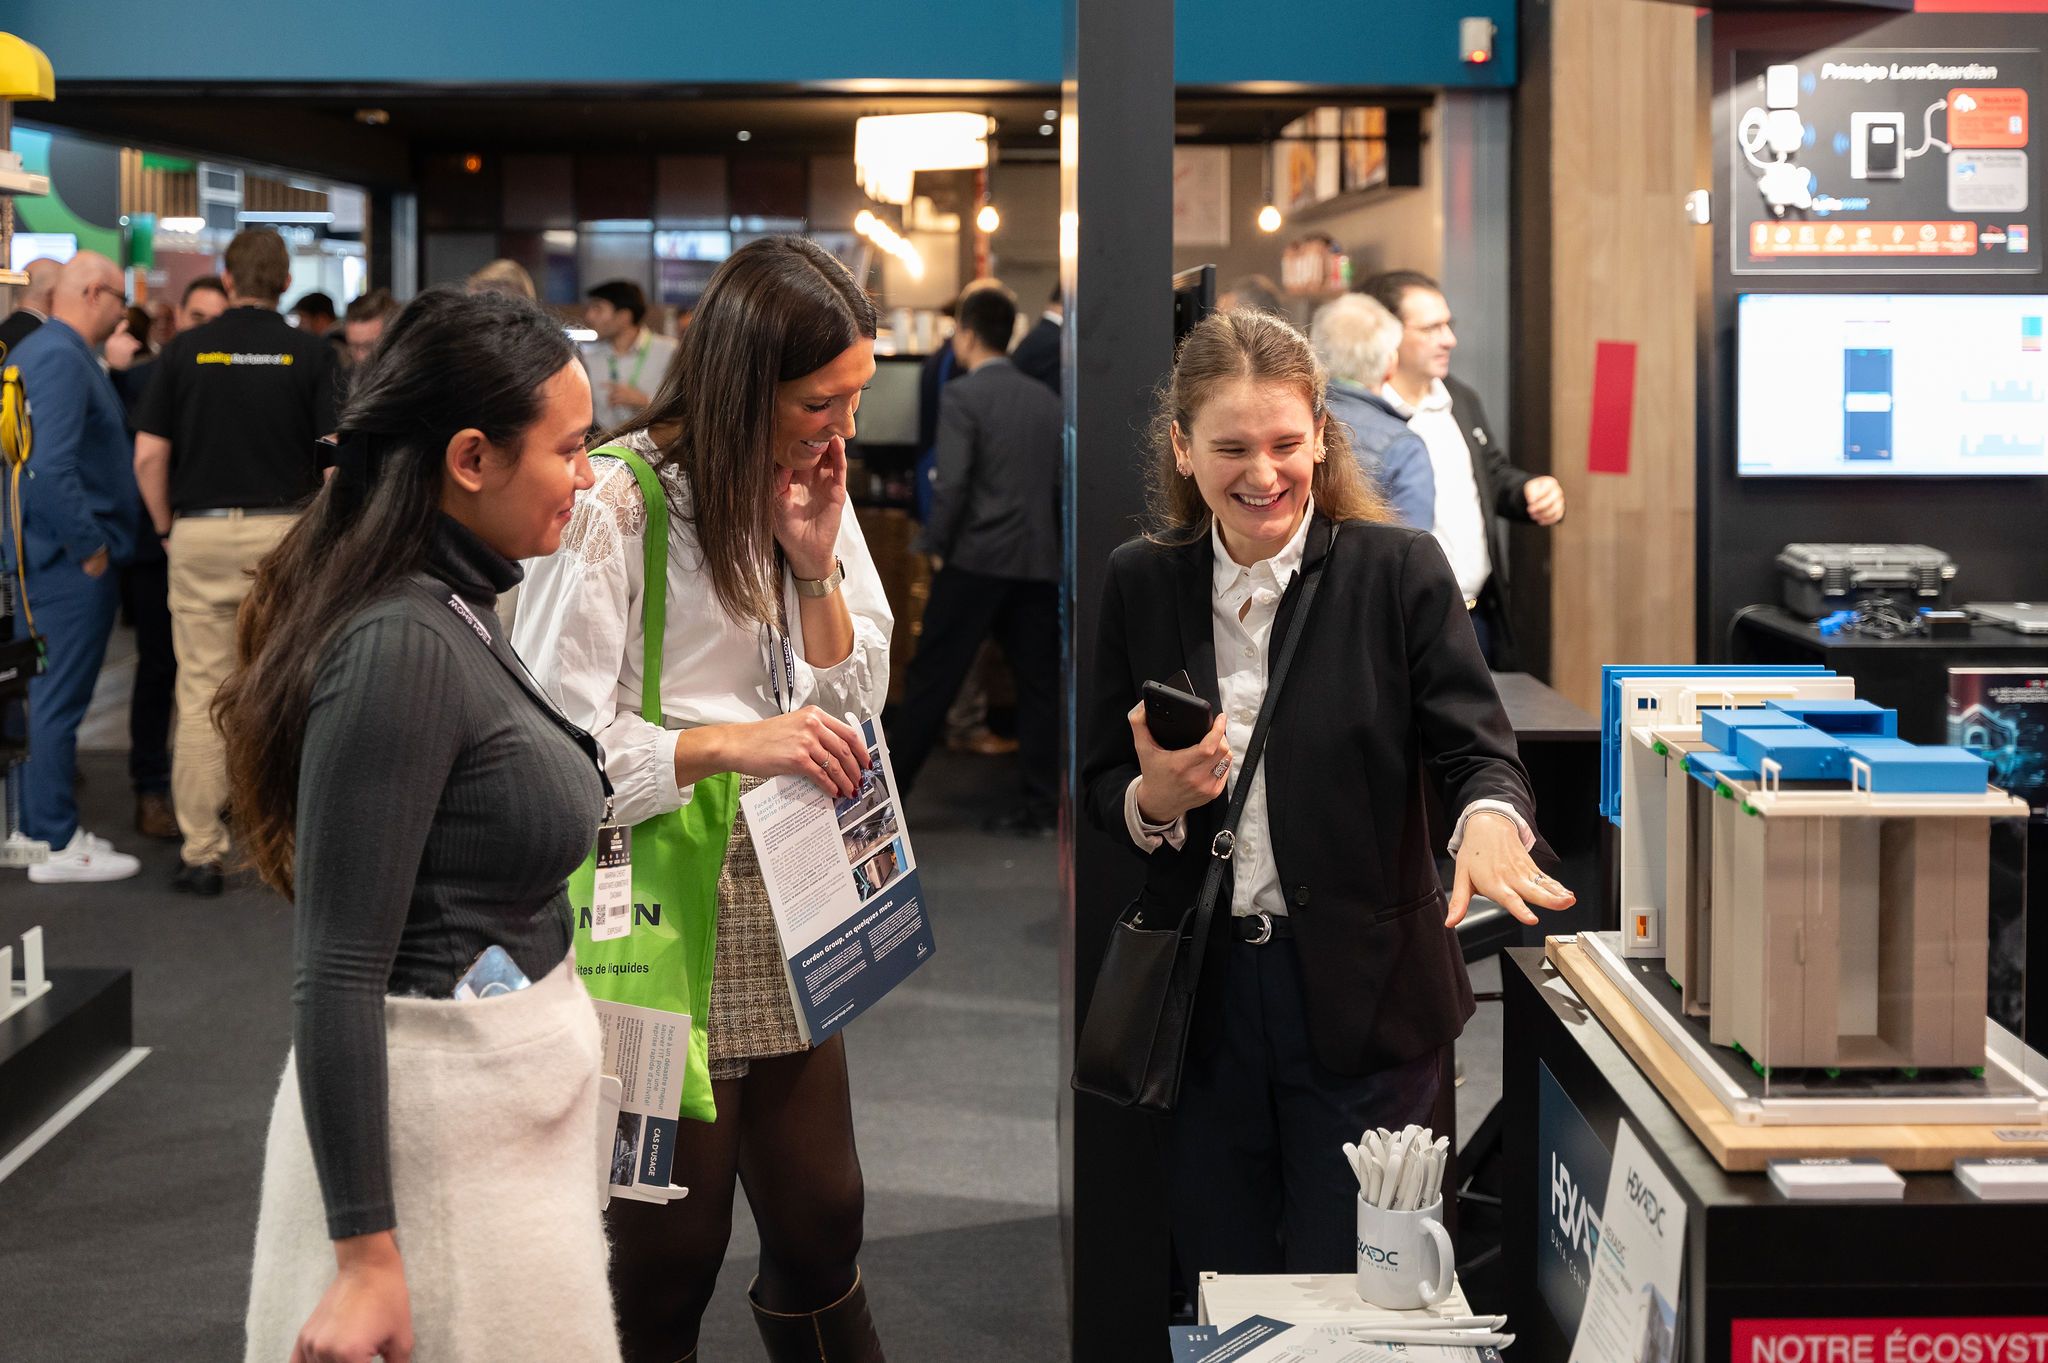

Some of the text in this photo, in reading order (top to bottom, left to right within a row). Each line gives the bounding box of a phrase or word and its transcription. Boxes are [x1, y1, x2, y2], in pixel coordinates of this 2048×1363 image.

[448, 599, 473, 625] SHOW
[472, 622, 491, 645] TECH
[801, 900, 893, 968] Cordon Group, en quelques mots
[575, 962, 649, 976] ites de liquides
[652, 1022, 661, 1046] reprise
[658, 1024, 667, 1047] sauver
[666, 1025, 675, 1041] Face
[649, 1048, 657, 1072] rapide
[664, 1047, 672, 1056] un
[660, 1057, 671, 1086] désastre
[648, 1143, 658, 1176] D'USAGE
[1551, 1151, 1602, 1278] HEXA
[1626, 1165, 1666, 1238] HEXADC
[1357, 1237, 1398, 1266] XADC
[1551, 1228, 1588, 1294] DATA CENT
[1751, 1335, 1875, 1363] NOTRE
